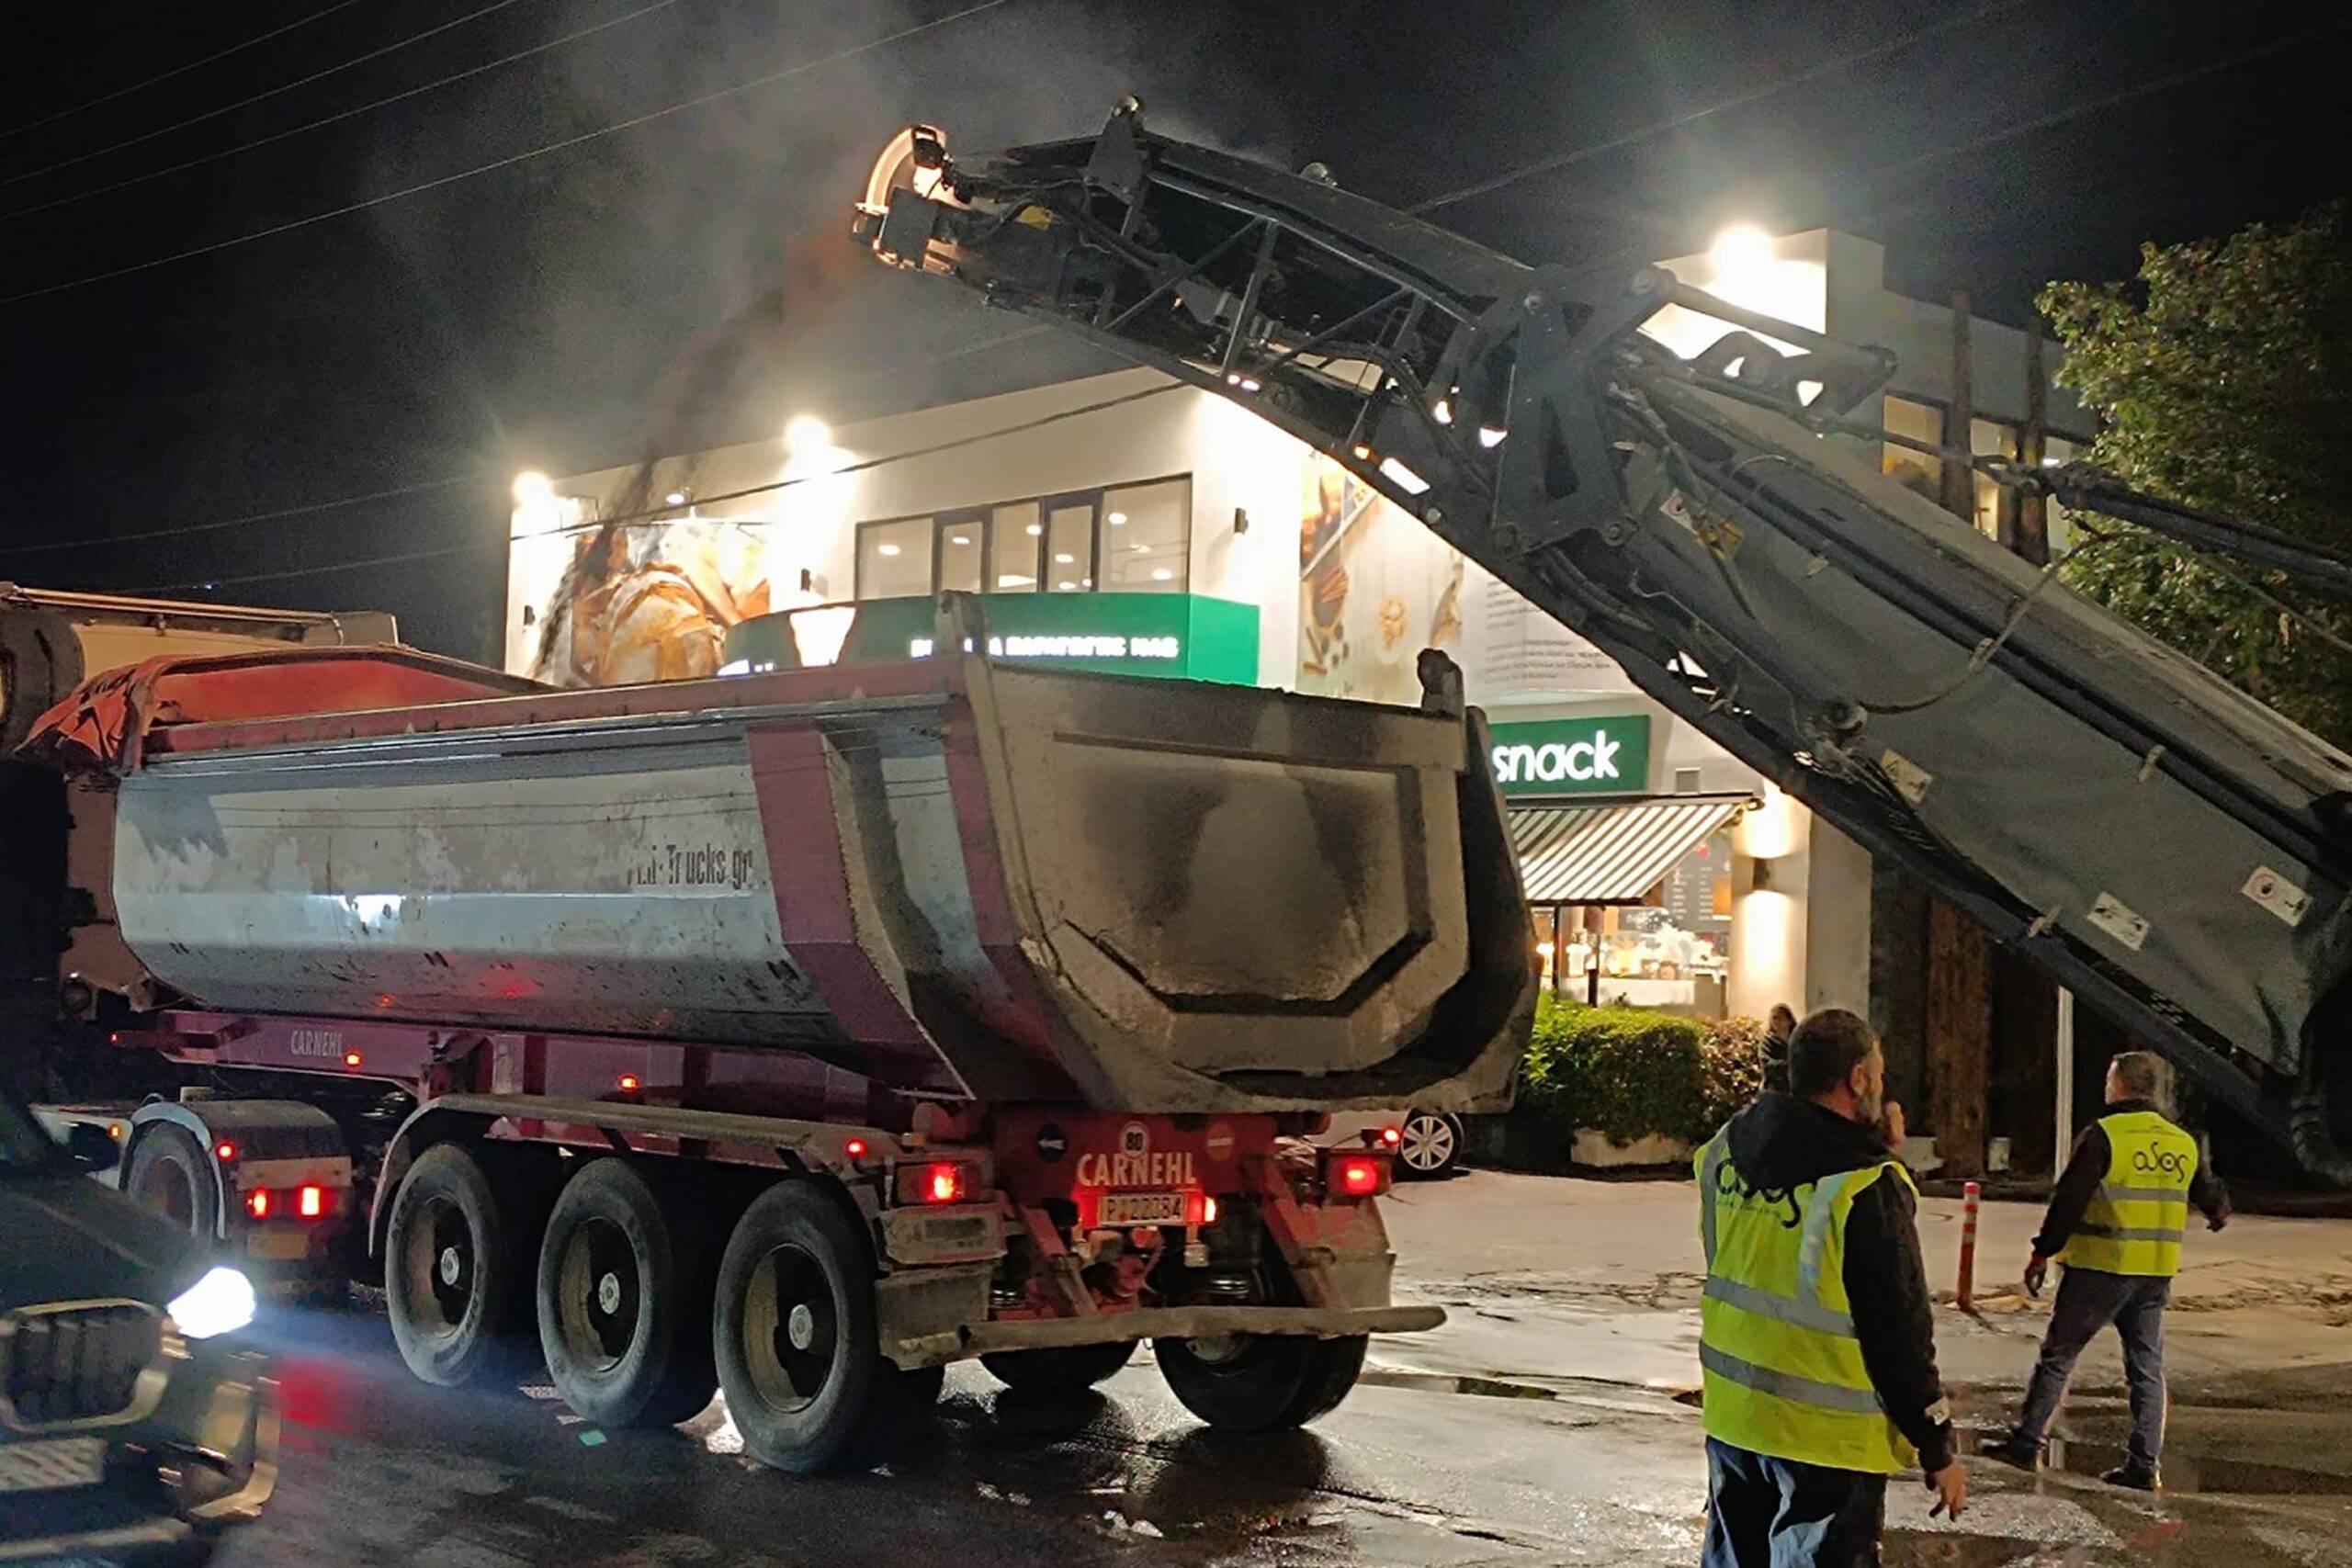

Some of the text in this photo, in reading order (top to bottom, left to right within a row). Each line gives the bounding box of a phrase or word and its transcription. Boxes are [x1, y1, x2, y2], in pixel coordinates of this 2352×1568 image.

[1492, 729, 1621, 783] snack
[290, 1030, 343, 1057] CARNEHL
[1077, 1152, 1196, 1187] CARNEHL
